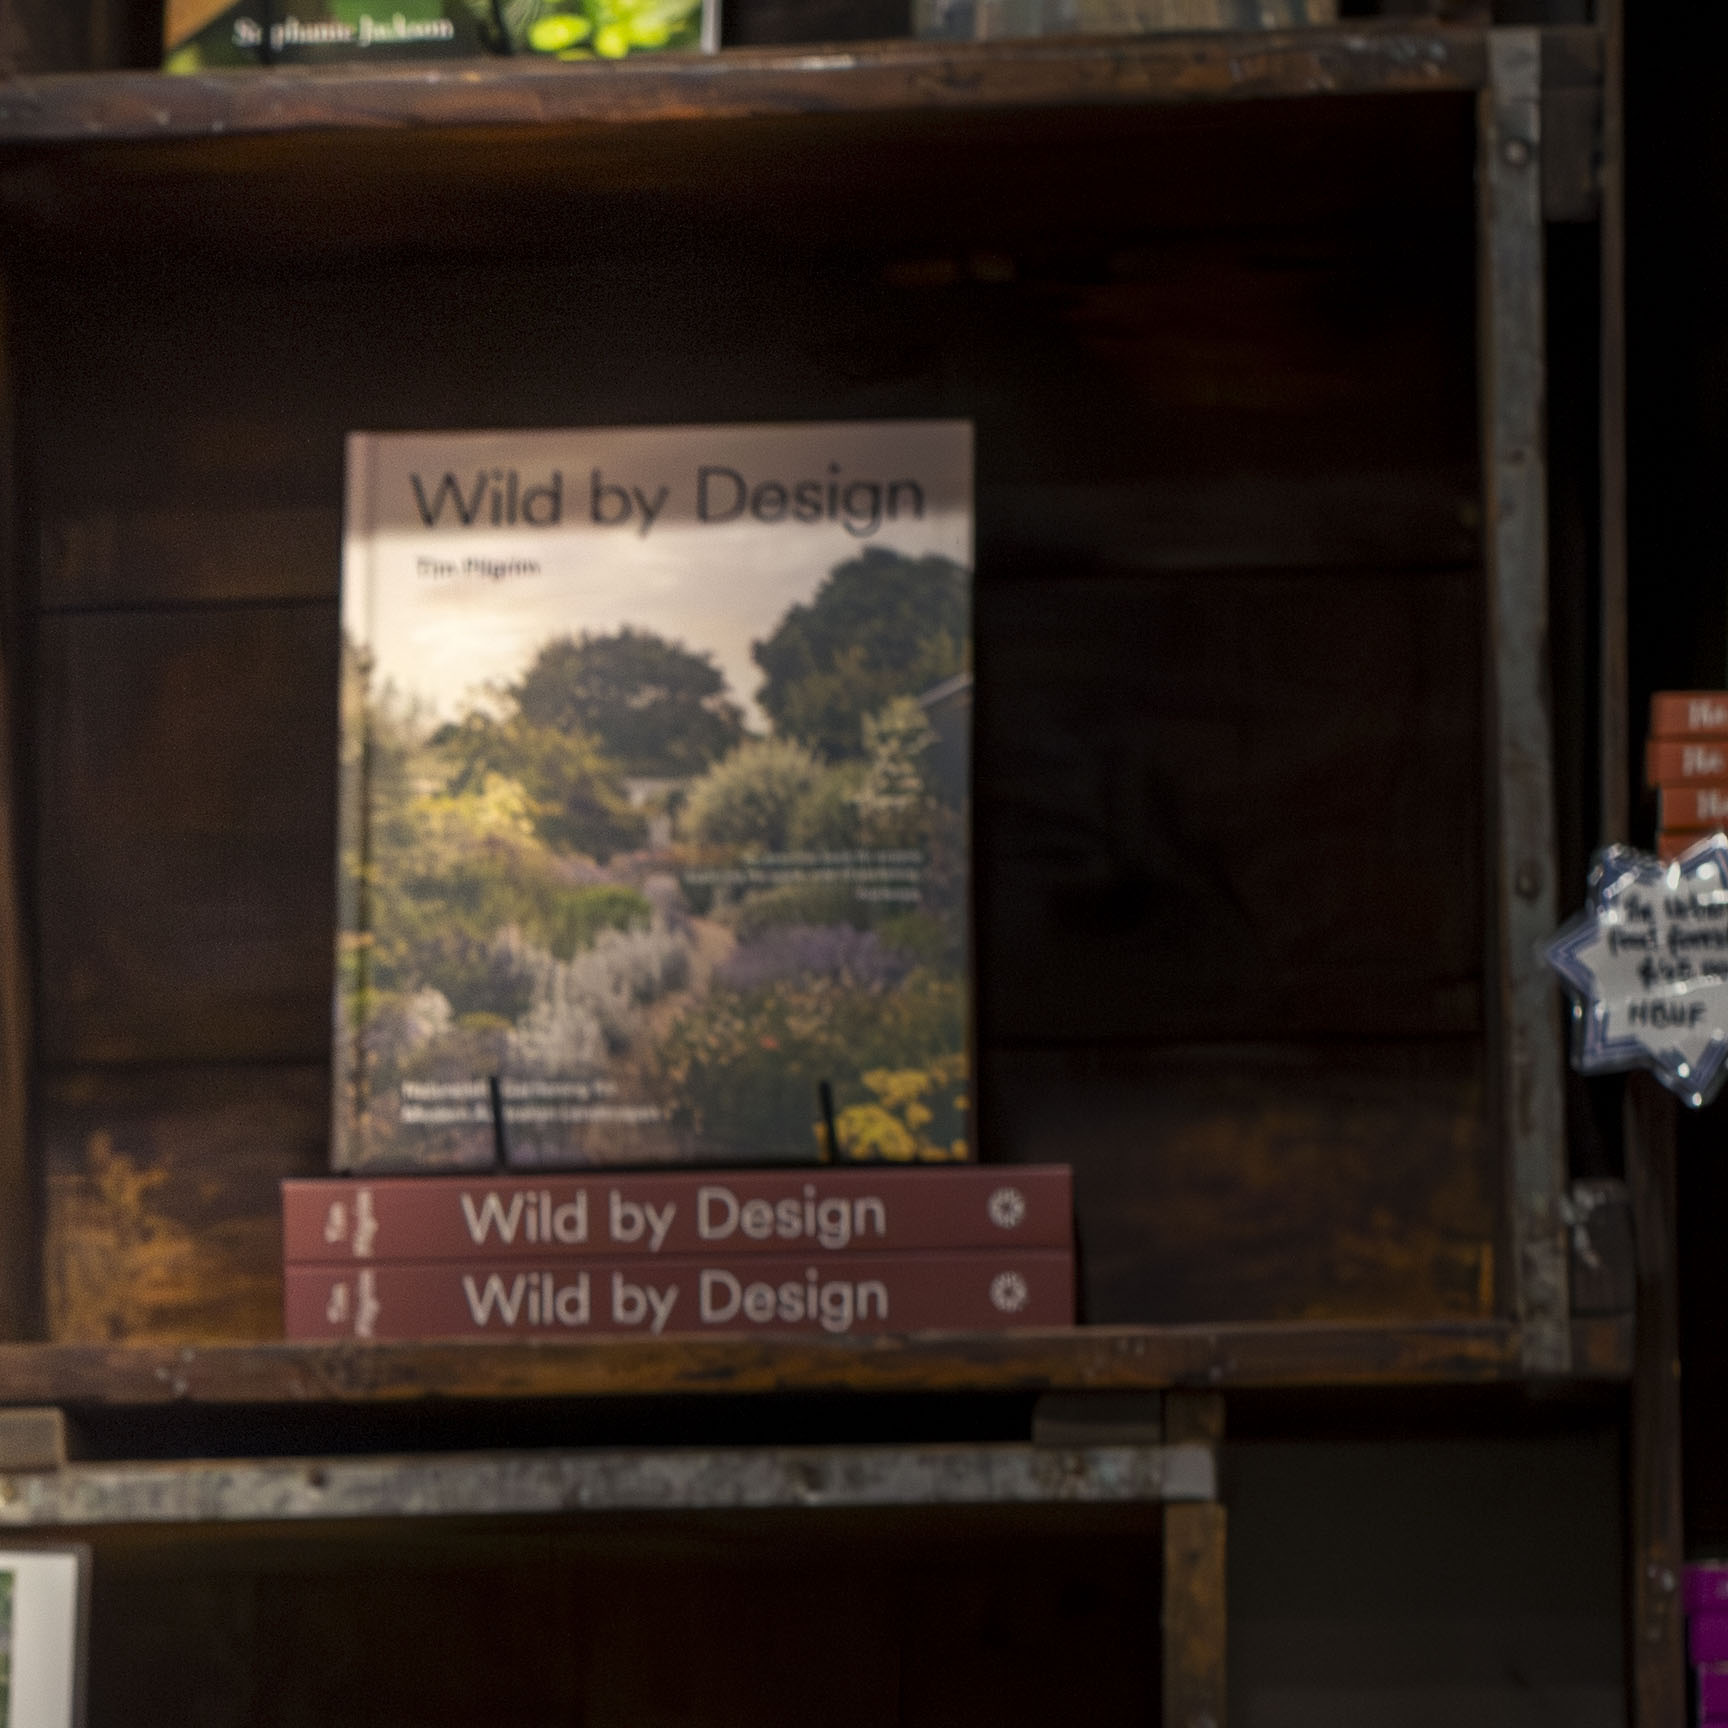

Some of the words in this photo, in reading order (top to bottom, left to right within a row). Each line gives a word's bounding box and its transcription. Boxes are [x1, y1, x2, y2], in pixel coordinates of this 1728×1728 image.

[233, 16, 353, 51] Stphanie
[411, 469, 564, 528] Wild
[592, 470, 669, 536] by
[697, 464, 926, 536] Design
[460, 1189, 588, 1245] Wild
[611, 1189, 676, 1251] by
[698, 1185, 886, 1248] Design
[463, 1270, 590, 1327] Wild
[614, 1272, 679, 1334] by
[700, 1268, 889, 1332] Design
